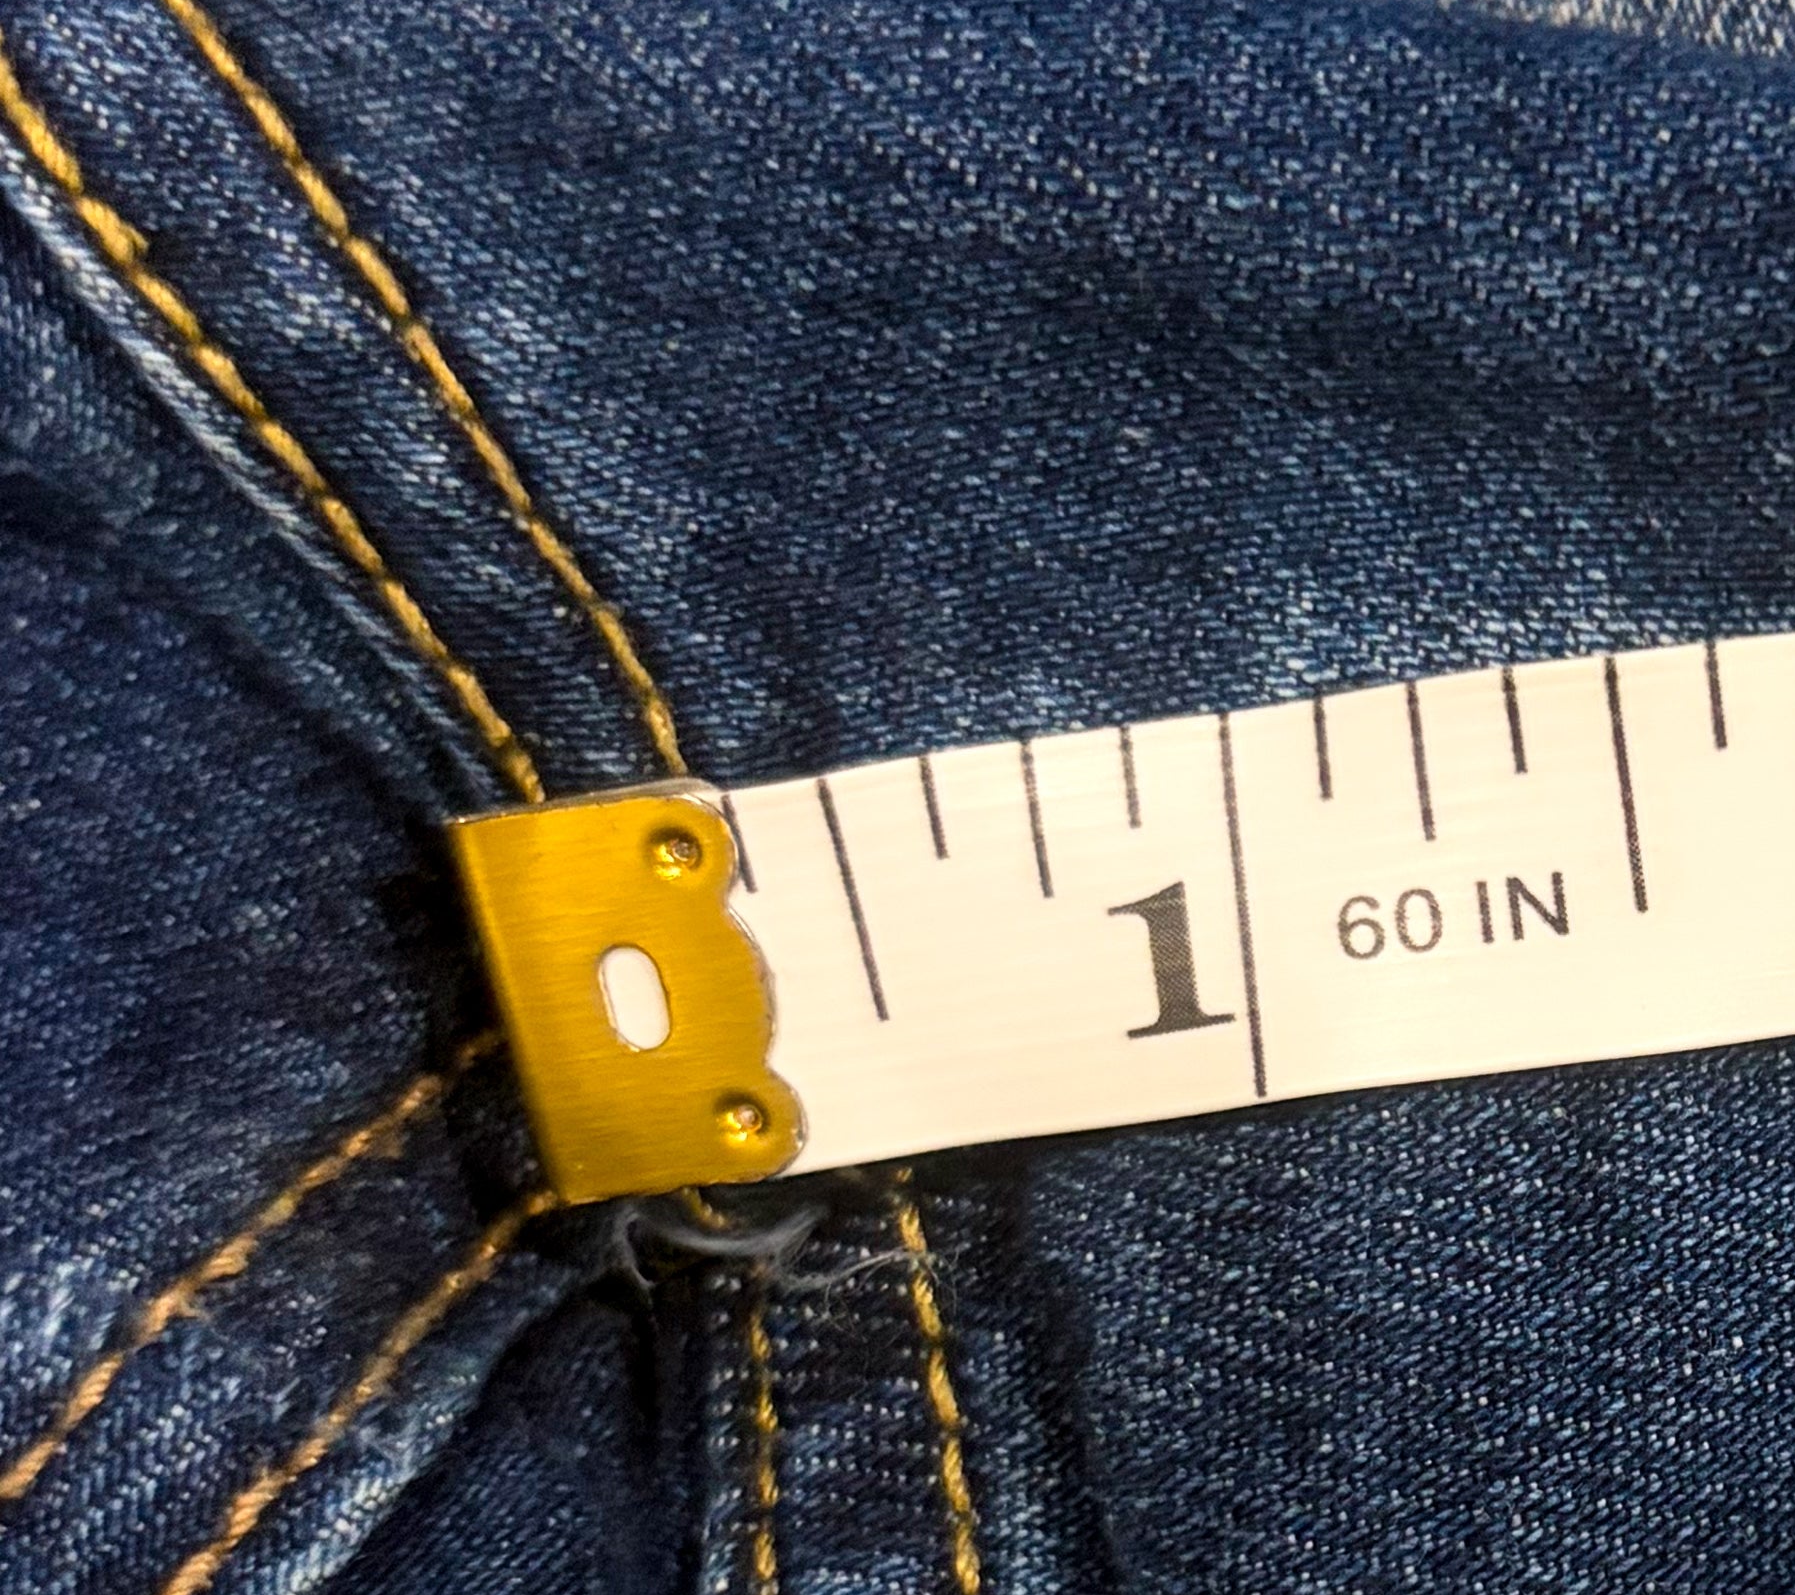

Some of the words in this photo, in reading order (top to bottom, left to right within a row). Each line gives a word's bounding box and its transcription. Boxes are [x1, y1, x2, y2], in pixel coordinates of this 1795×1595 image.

[1106, 881, 1236, 1040] 1
[1336, 887, 1444, 961] 60
[1476, 870, 1571, 944] IN
